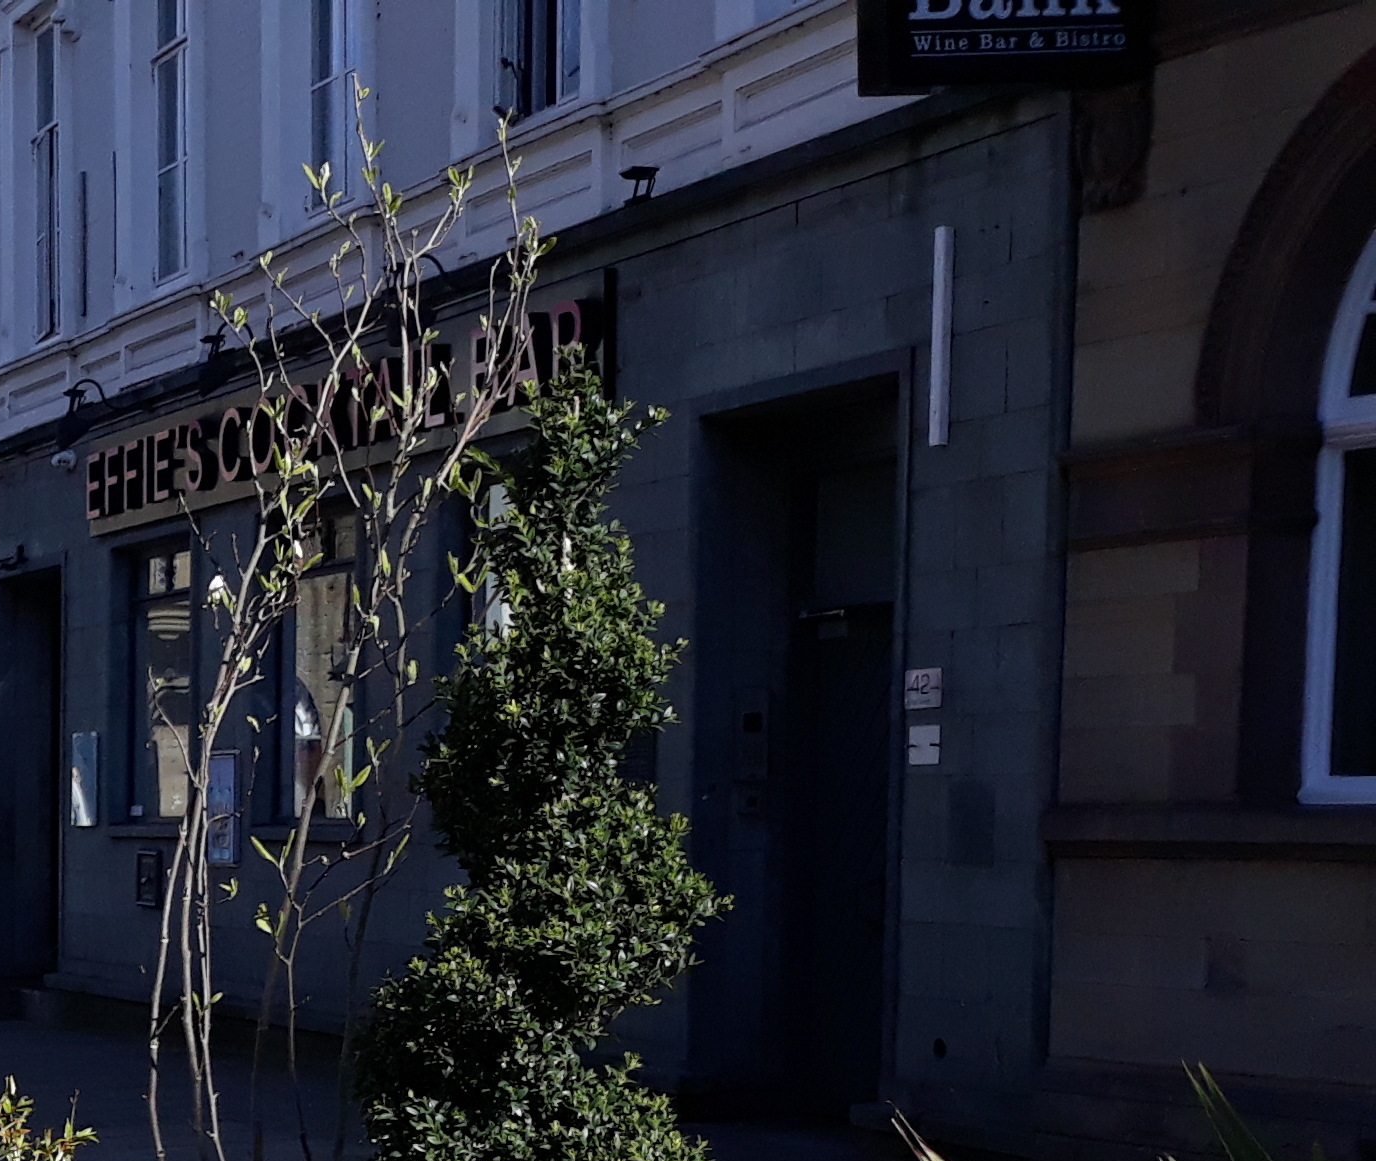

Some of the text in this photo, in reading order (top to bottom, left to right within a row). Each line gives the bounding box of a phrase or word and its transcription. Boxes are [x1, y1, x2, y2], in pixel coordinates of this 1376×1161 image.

[913, 30, 1126, 51] Wine Bar & Bistro
[86, 419, 203, 520] EFFIE'S
[908, 673, 930, 694] 42
